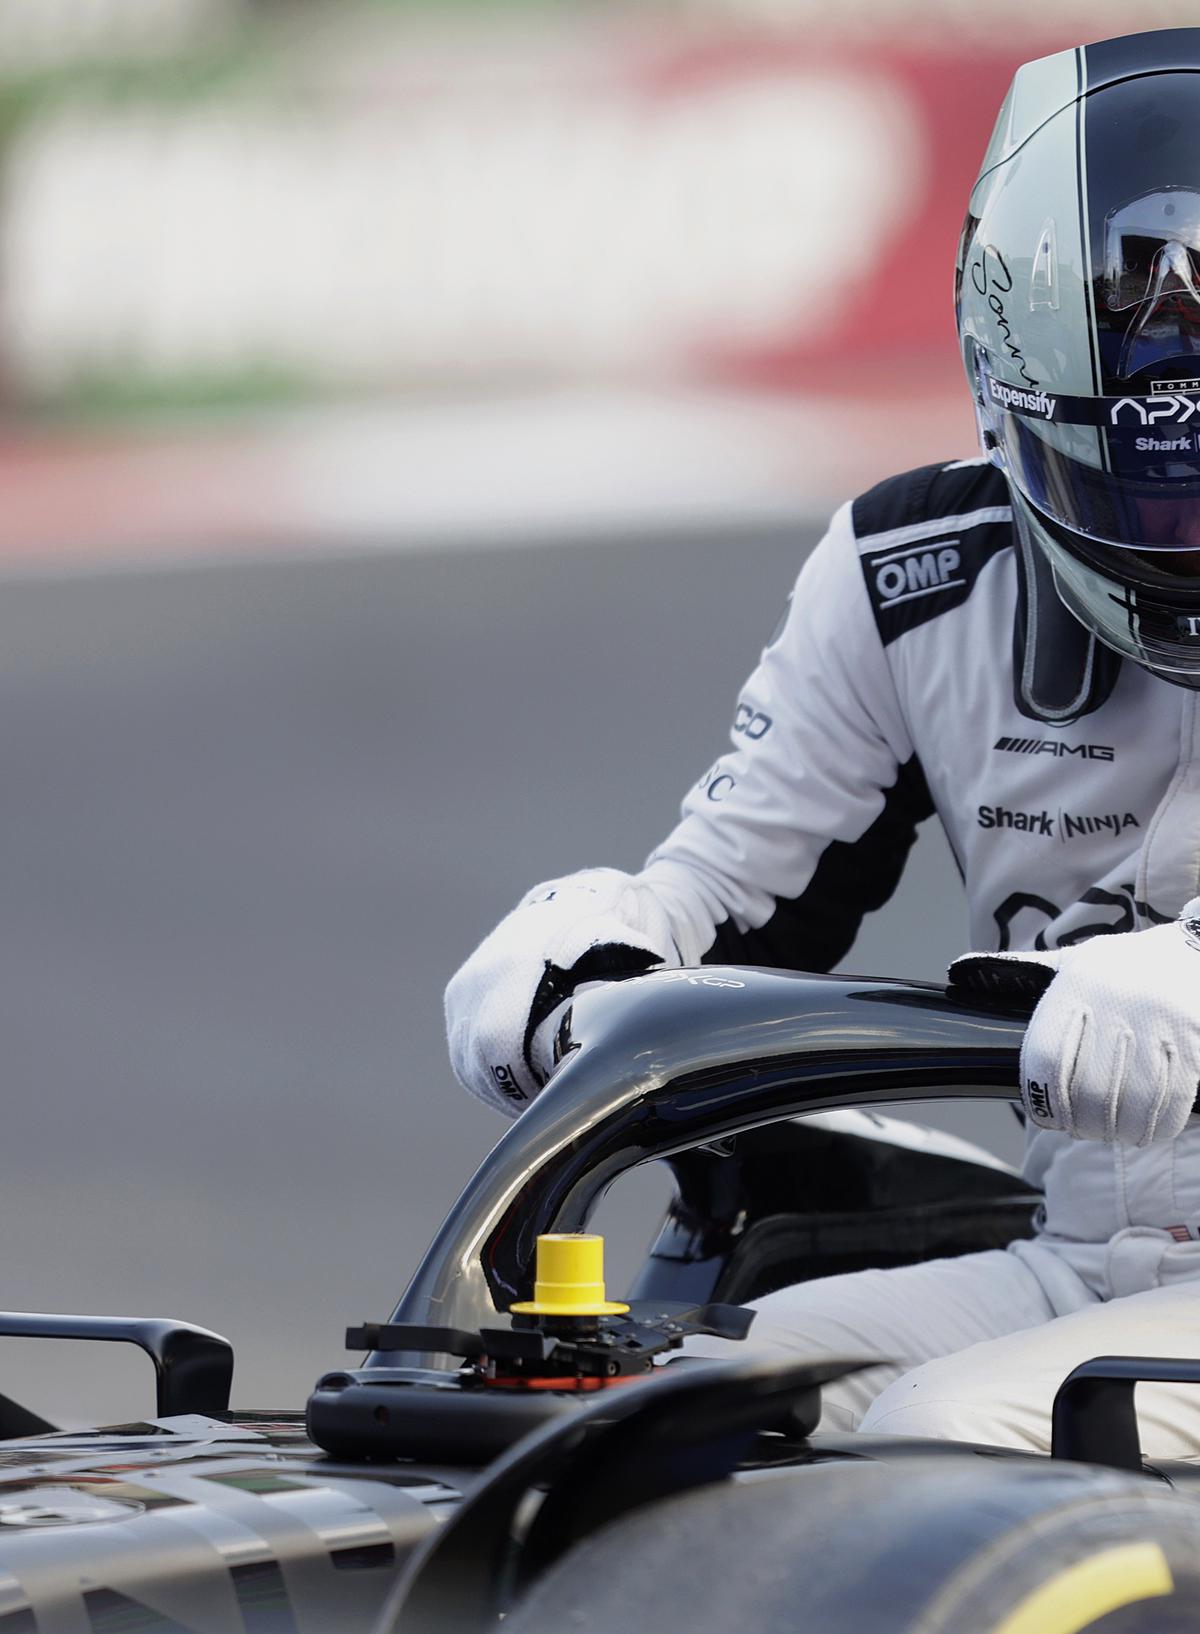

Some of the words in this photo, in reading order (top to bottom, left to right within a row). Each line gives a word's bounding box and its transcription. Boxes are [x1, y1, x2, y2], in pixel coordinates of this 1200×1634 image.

[988, 377, 1057, 420] Expensify
[1134, 436, 1193, 451] Shark
[875, 548, 961, 599] OMP
[1036, 740, 1115, 762] AMG
[977, 805, 1055, 838] Shark
[1063, 812, 1140, 839] NINJA
[494, 1065, 524, 1101] OMP
[1029, 1080, 1049, 1118] OMP
